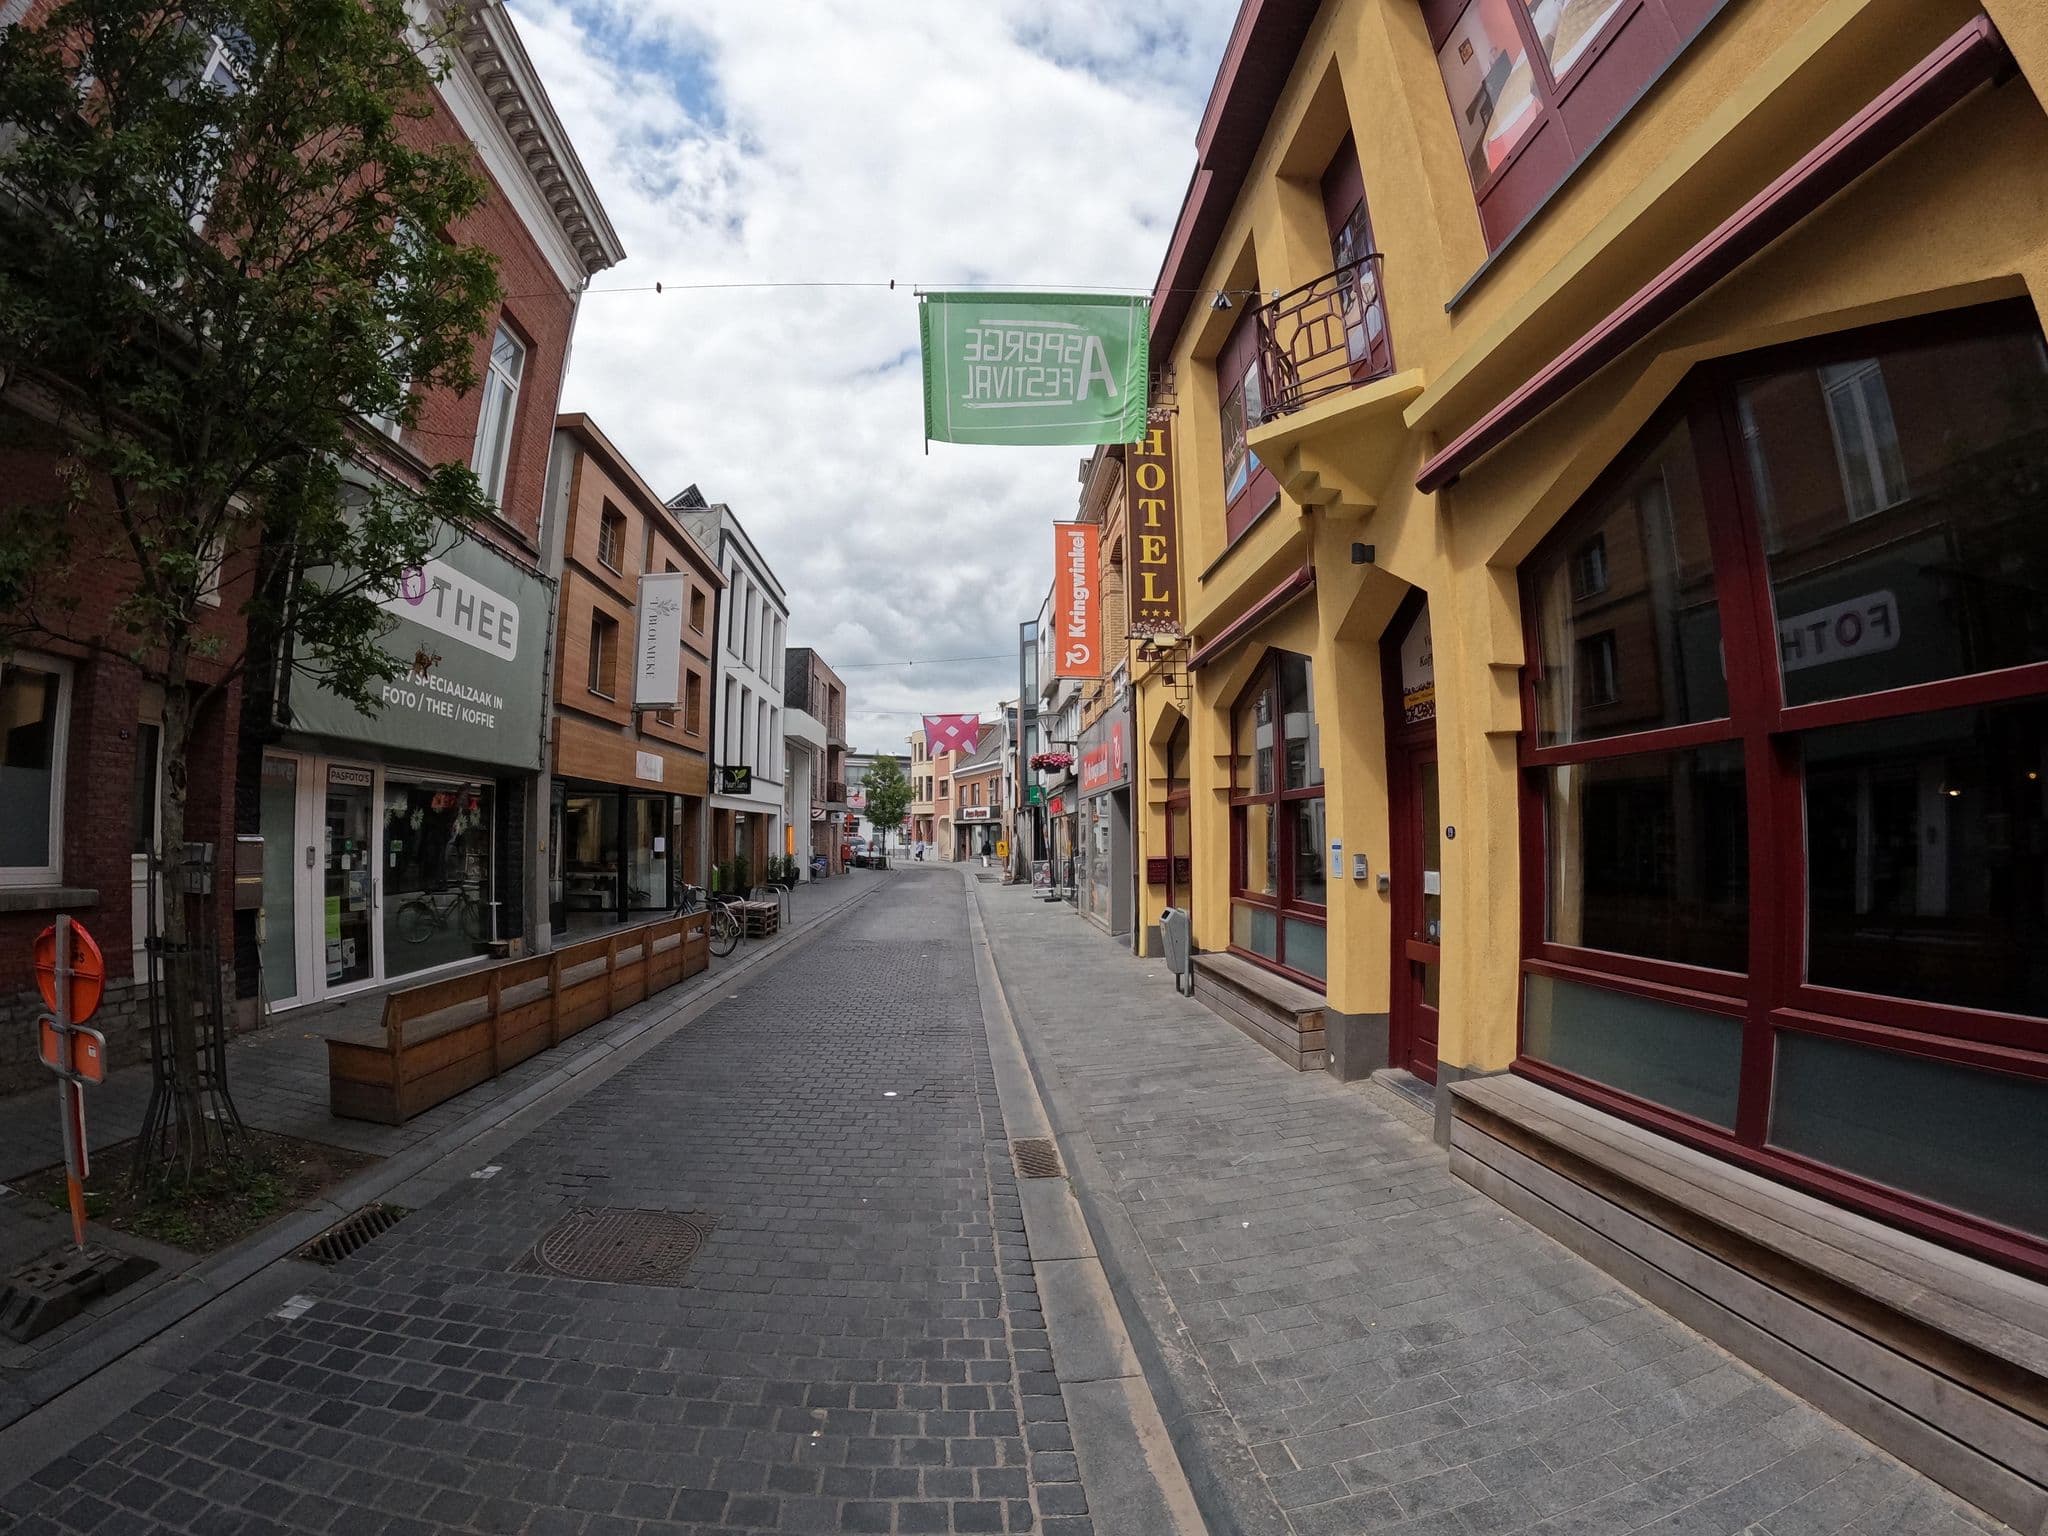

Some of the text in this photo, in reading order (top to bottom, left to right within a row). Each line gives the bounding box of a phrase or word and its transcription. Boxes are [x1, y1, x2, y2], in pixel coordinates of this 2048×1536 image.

[1133, 428, 1169, 603] HOTEL
[401, 565, 514, 650] OTHEE
[1067, 531, 1090, 638] Kringwinkel
[382, 685, 496, 729] FOTO / THEE / KOFFIE
[415, 672, 492, 708] SPECIAALZAAK
[493, 695, 504, 710] IN
[330, 770, 370, 783] PASFOTO'S
